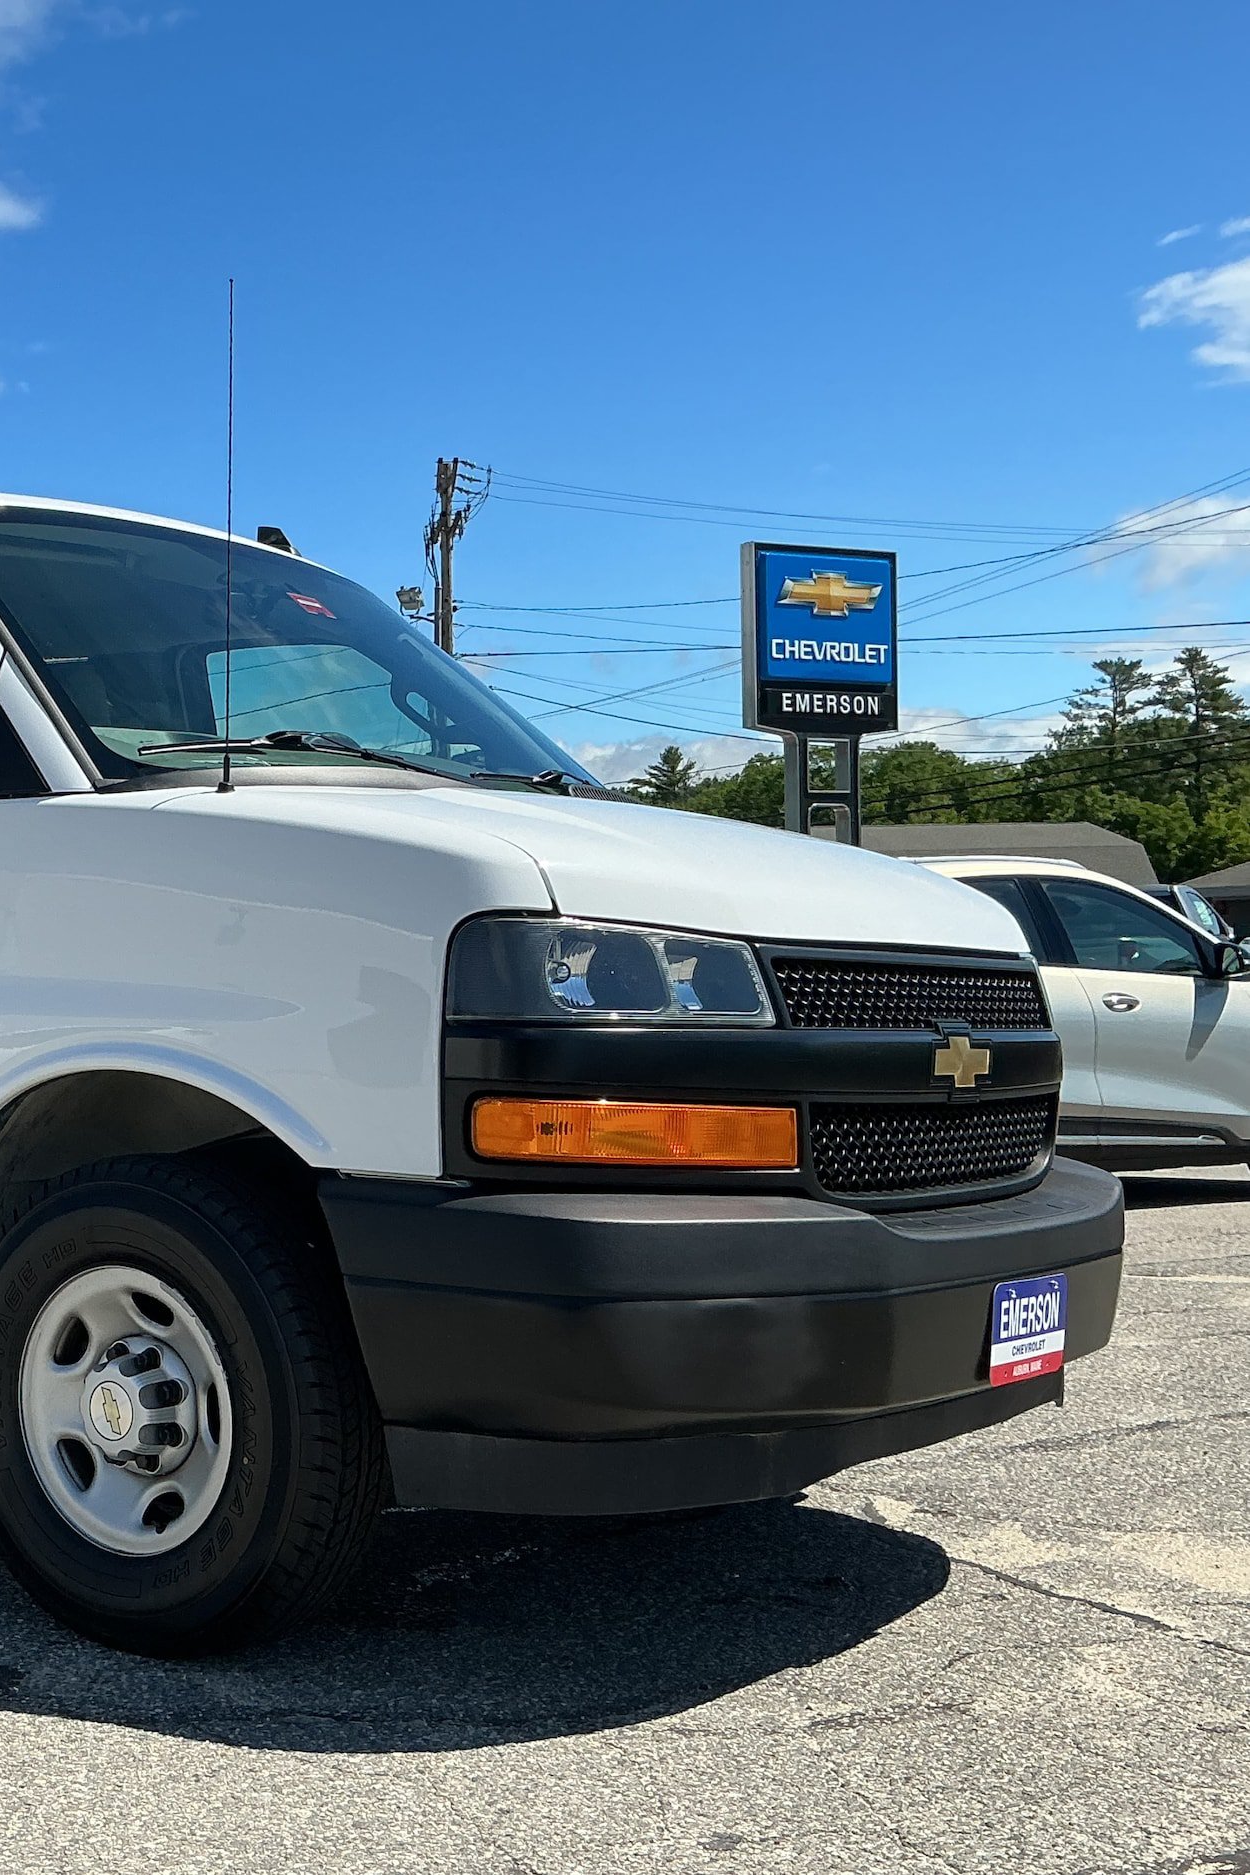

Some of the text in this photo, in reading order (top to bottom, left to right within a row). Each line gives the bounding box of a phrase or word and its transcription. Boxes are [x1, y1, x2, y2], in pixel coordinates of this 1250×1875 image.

[771, 639, 888, 664] CHEVROLET
[781, 692, 880, 716] EMERSON
[41, 1238, 78, 1270] HD
[999, 1291, 1061, 1339] EMERSON
[1011, 1339, 1046, 1356] CHEVROLET
